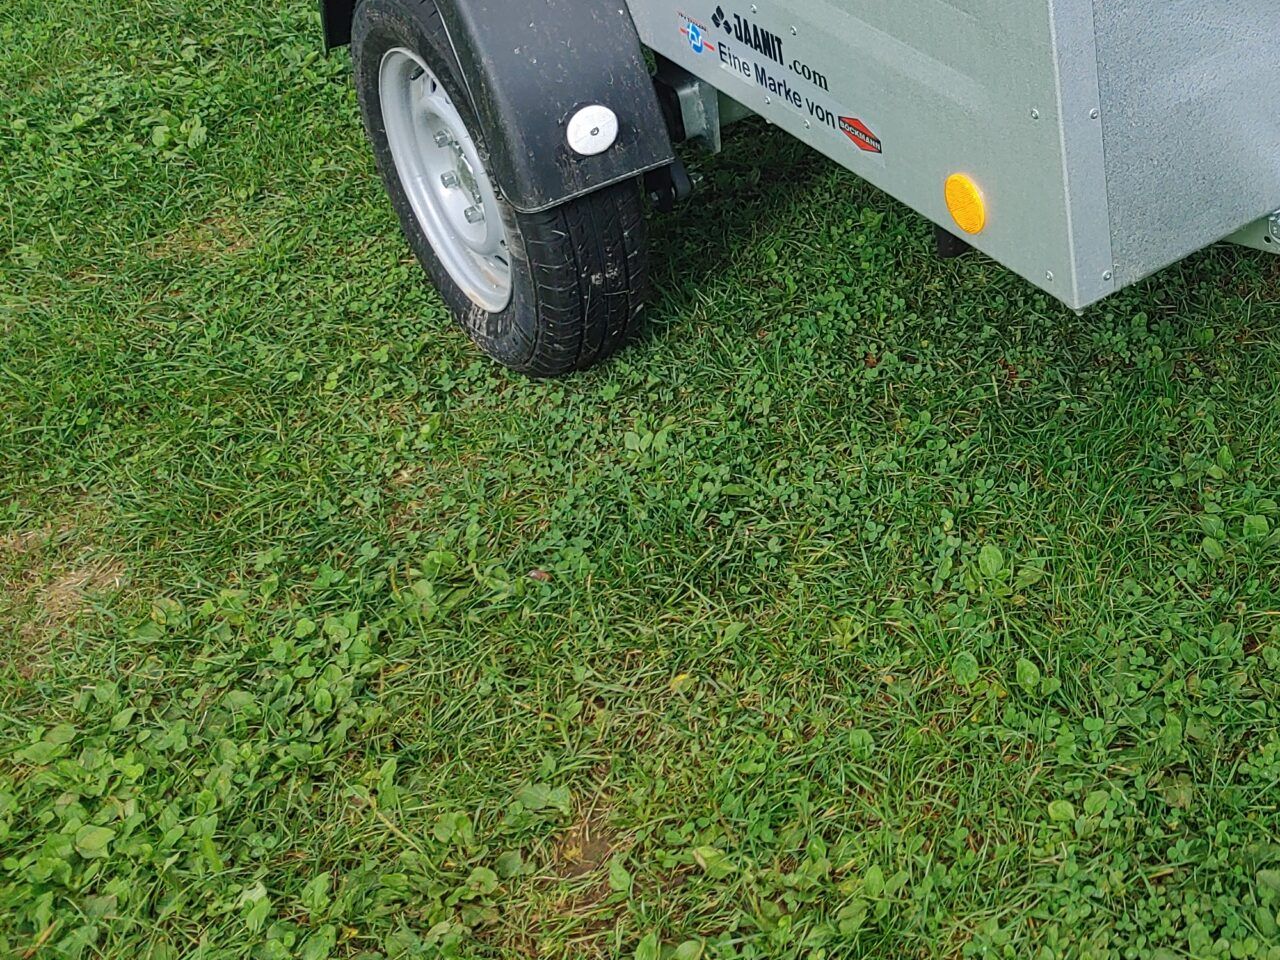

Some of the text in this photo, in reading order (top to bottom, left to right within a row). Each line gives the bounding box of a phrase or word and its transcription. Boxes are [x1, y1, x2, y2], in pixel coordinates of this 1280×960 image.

[718, 41, 751, 78] Eine
[754, 62, 802, 108] Marke
[806, 98, 836, 129] von
[733, 13, 784, 65] JAANIT
[789, 60, 829, 92] .com
